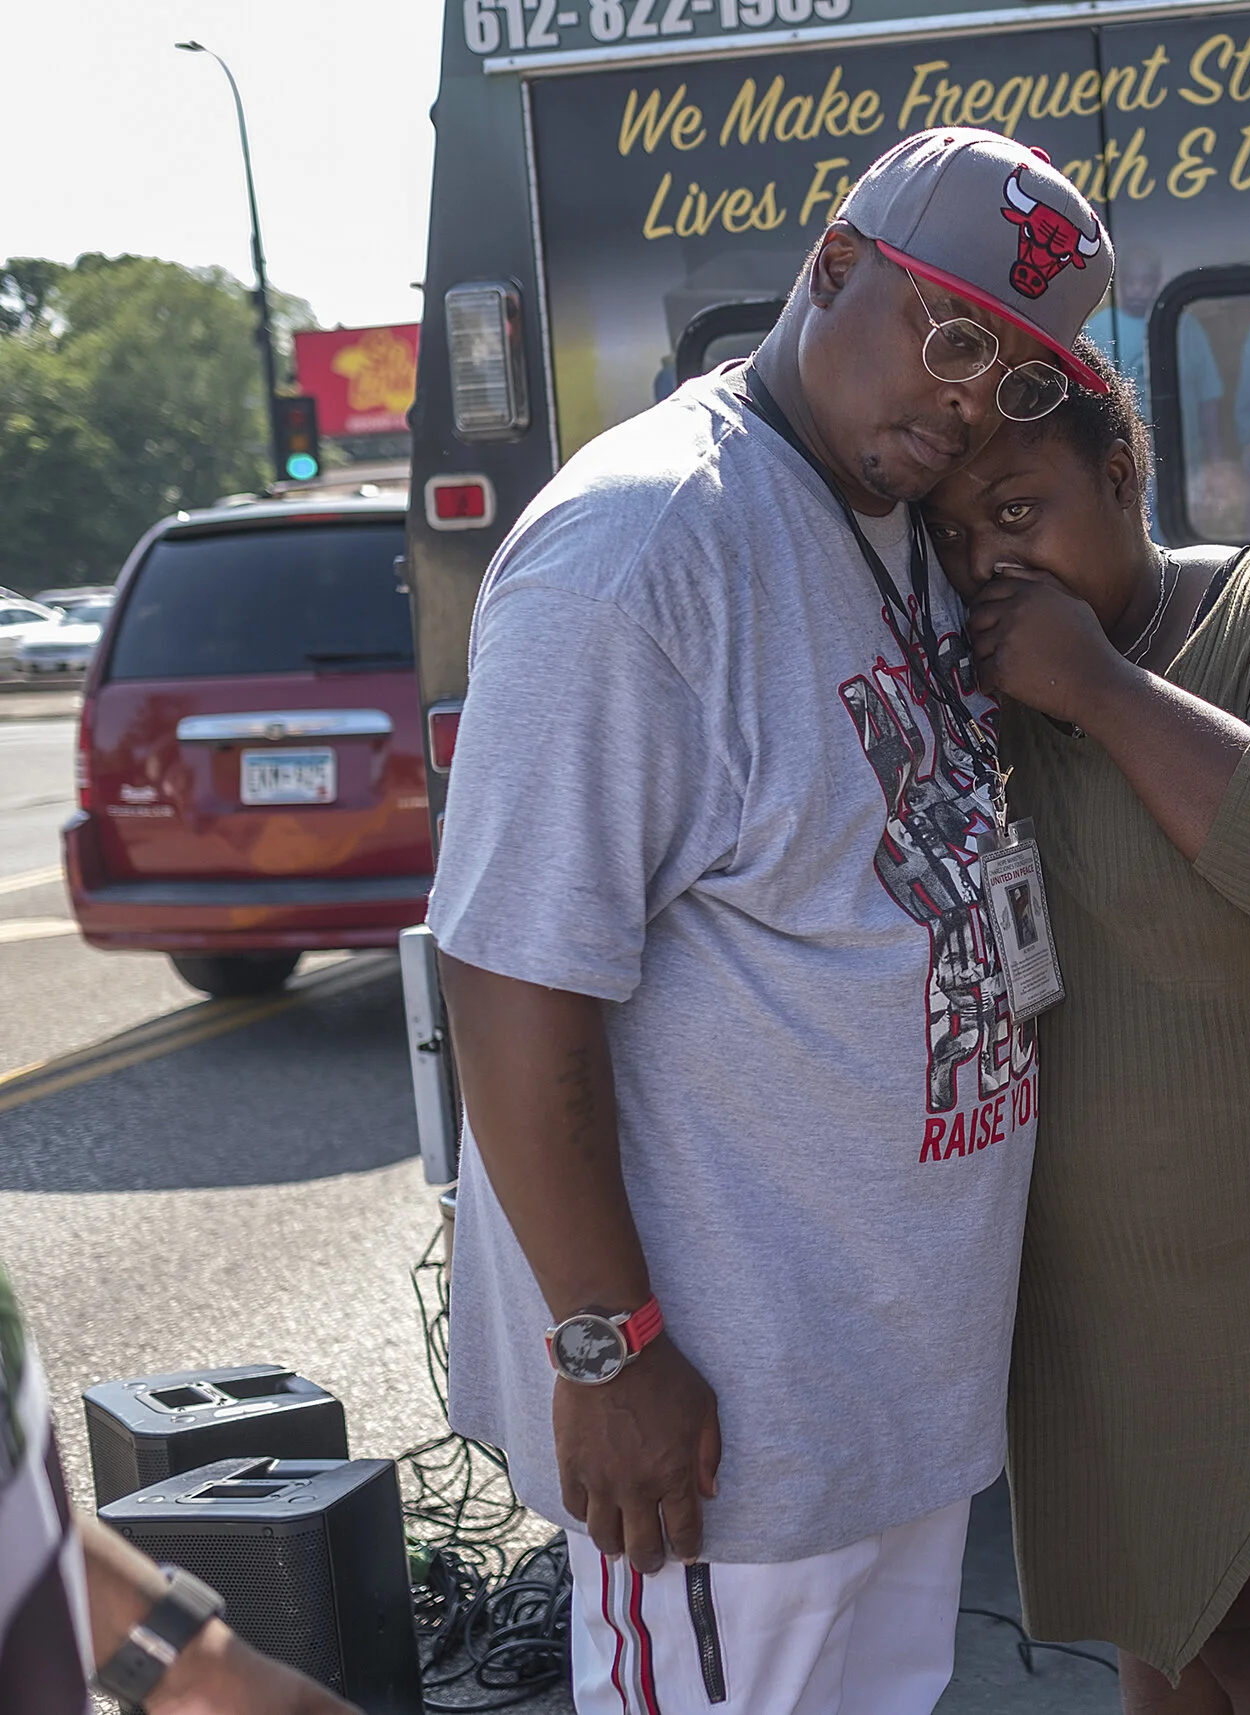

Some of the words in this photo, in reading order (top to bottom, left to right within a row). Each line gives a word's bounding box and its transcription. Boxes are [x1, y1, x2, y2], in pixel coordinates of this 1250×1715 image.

[463, 0, 581, 54] 612-
[617, 84, 706, 157] We
[718, 66, 886, 149] Make
[899, 45, 1169, 138] Frequent
[641, 172, 787, 240] Lives
[799, 157, 858, 226] Fr
[1062, 126, 1156, 203] ath
[1167, 126, 1218, 199] &
[990, 872, 1013, 887] UNITED
[1013, 869, 1020, 880] IN
[1020, 863, 1035, 876] PEACE
[919, 1095, 1006, 1163] RAISE
